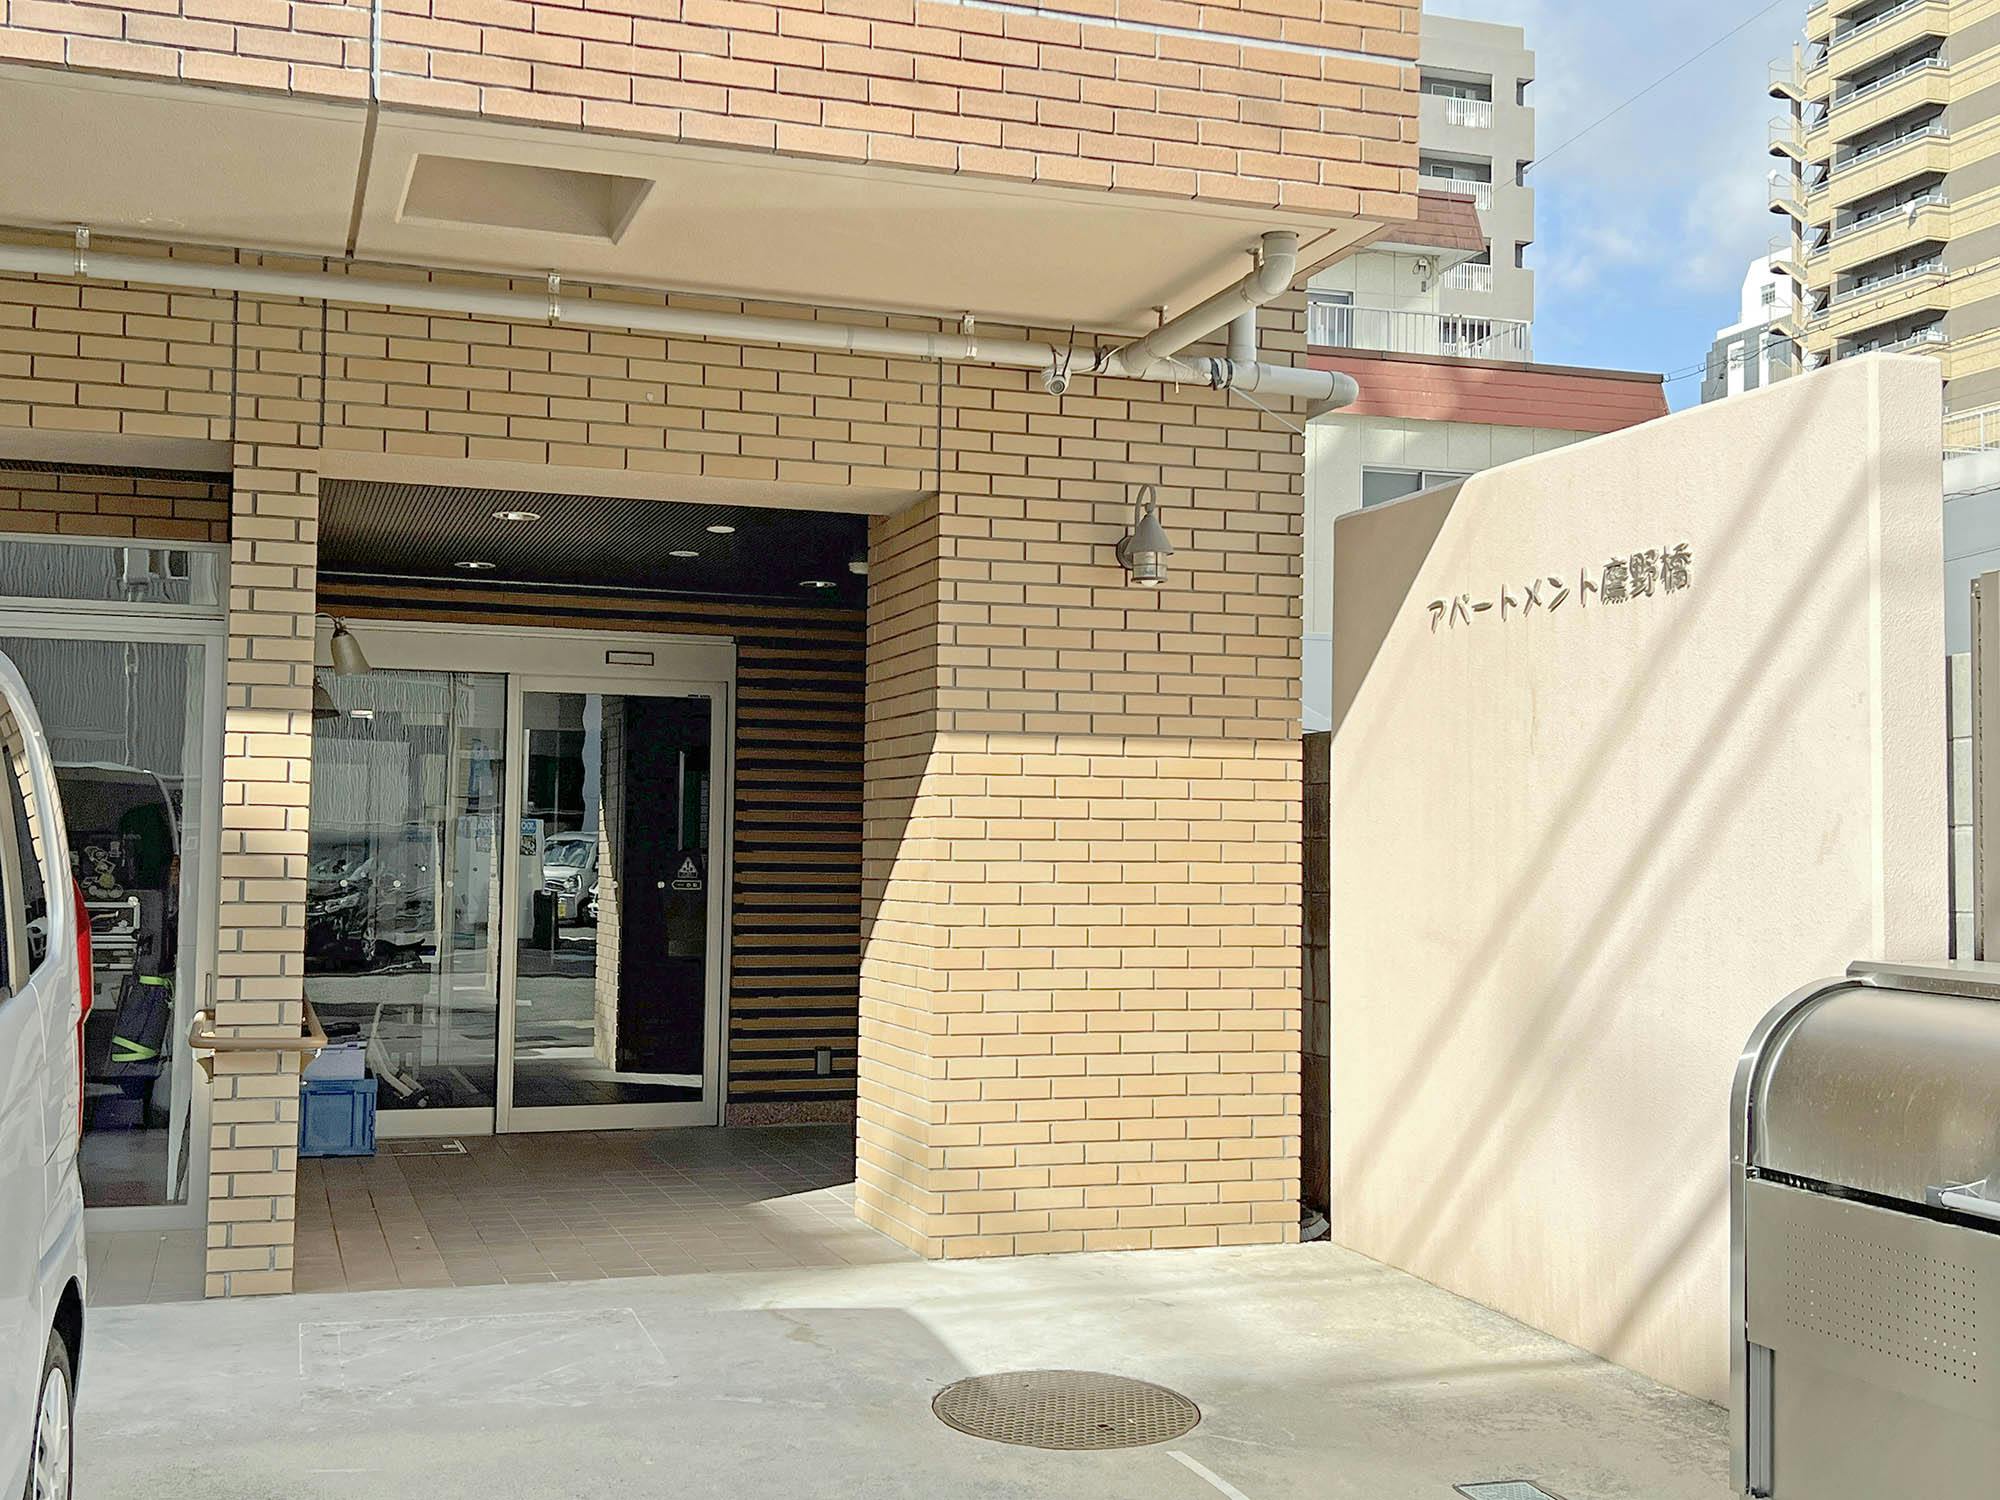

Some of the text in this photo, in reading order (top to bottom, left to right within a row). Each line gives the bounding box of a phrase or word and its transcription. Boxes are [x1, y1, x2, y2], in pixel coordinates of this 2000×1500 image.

[1427, 543, 1692, 634] アパートメント鷹野橋
